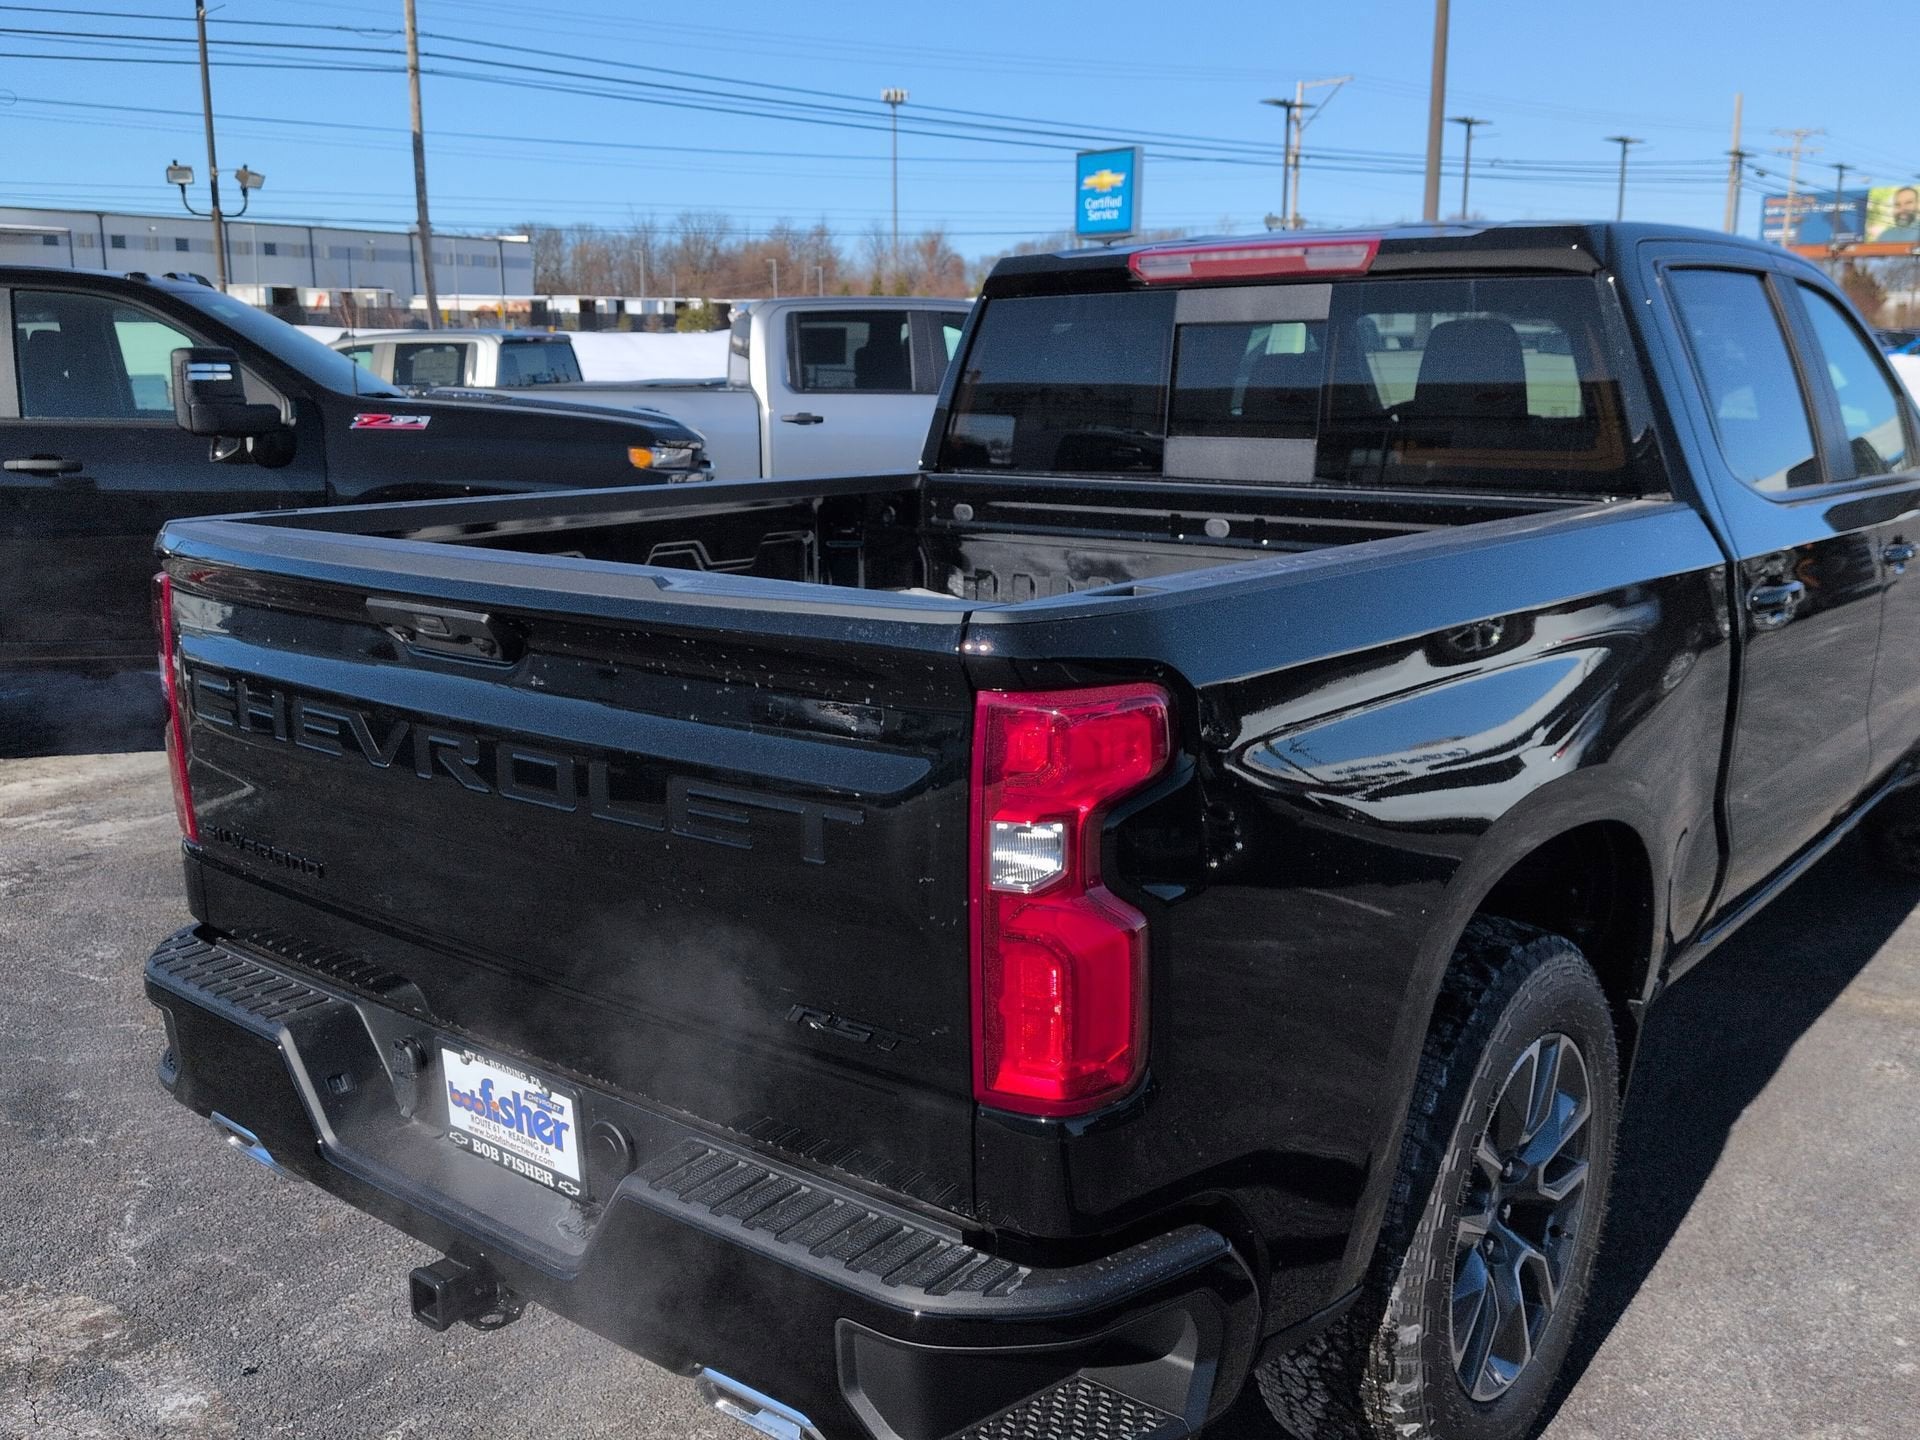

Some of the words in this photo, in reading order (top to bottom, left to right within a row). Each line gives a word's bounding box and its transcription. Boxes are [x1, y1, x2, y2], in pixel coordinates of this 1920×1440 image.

[1084, 195, 1123, 210] Certified
[1087, 208, 1119, 221] Service
[190, 672, 866, 864] CHEVROLET
[470, 1114, 492, 1131] ROUTE
[492, 1123, 500, 1134] 61
[468, 1124, 556, 1168] www.bobfisherchevy.com
[472, 1138, 500, 1161] BOB
[503, 1152, 555, 1188] FISHER
